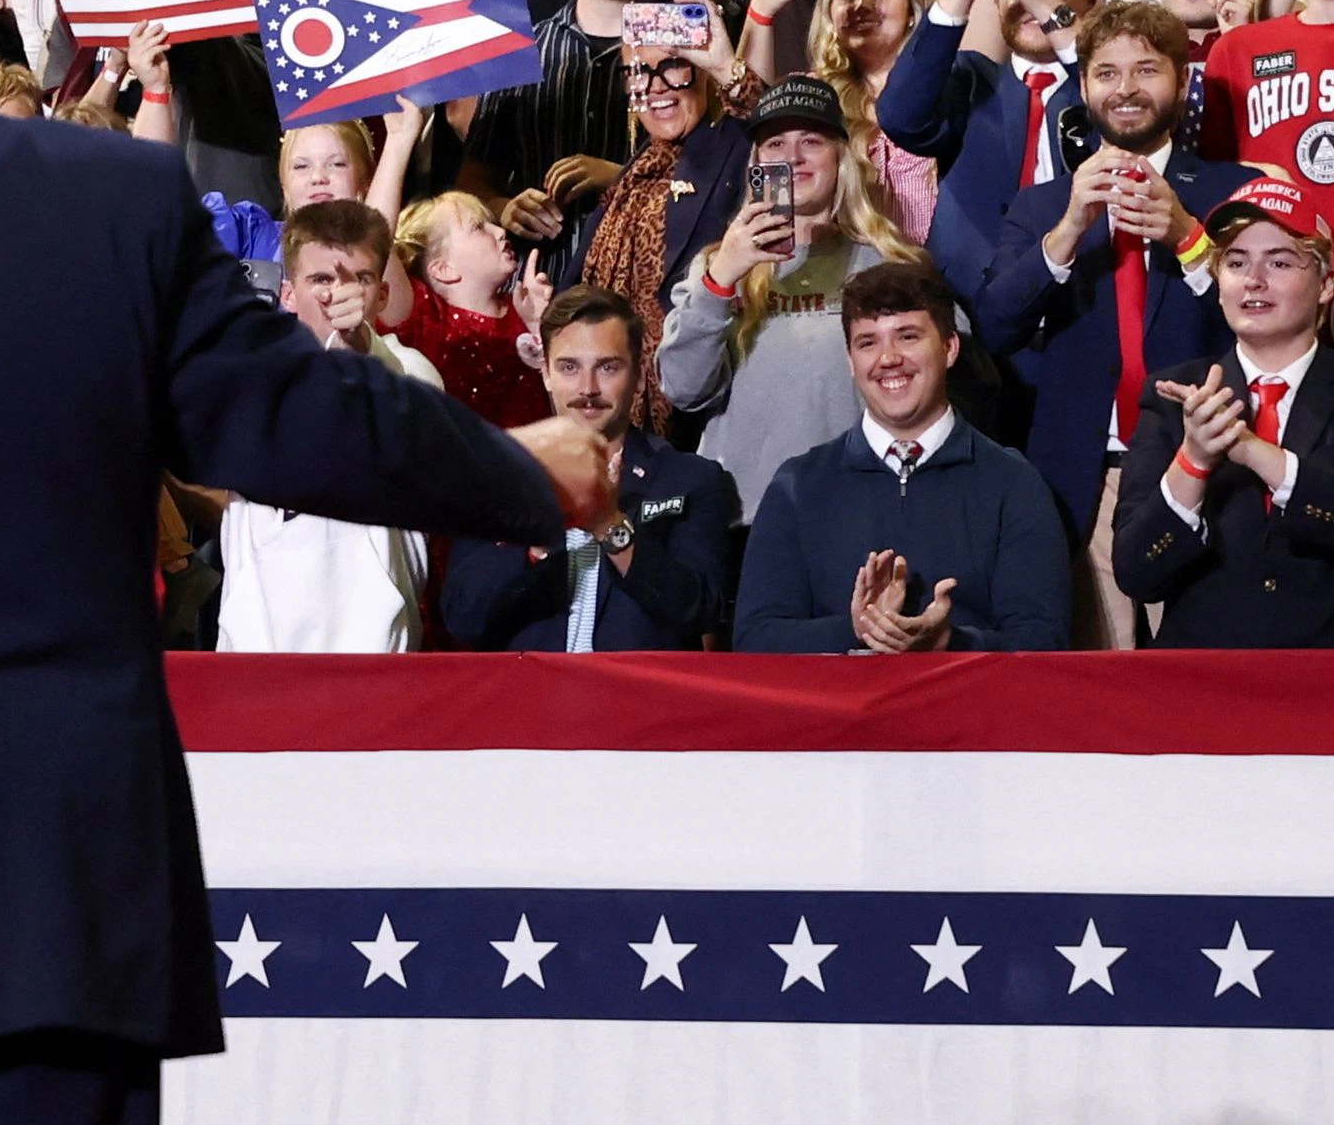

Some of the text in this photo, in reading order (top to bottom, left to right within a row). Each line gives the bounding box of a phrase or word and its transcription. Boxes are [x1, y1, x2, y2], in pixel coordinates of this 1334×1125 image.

[1255, 54, 1294, 70] FABER
[784, 81, 833, 100] AMERICA
[759, 95, 827, 115] GREAT AGAIN
[1246, 71, 1311, 139] OHIO
[1254, 183, 1302, 203] AMERICA
[1260, 197, 1294, 215] AGAIN
[767, 290, 825, 312] STATE
[643, 498, 681, 516] FABER
